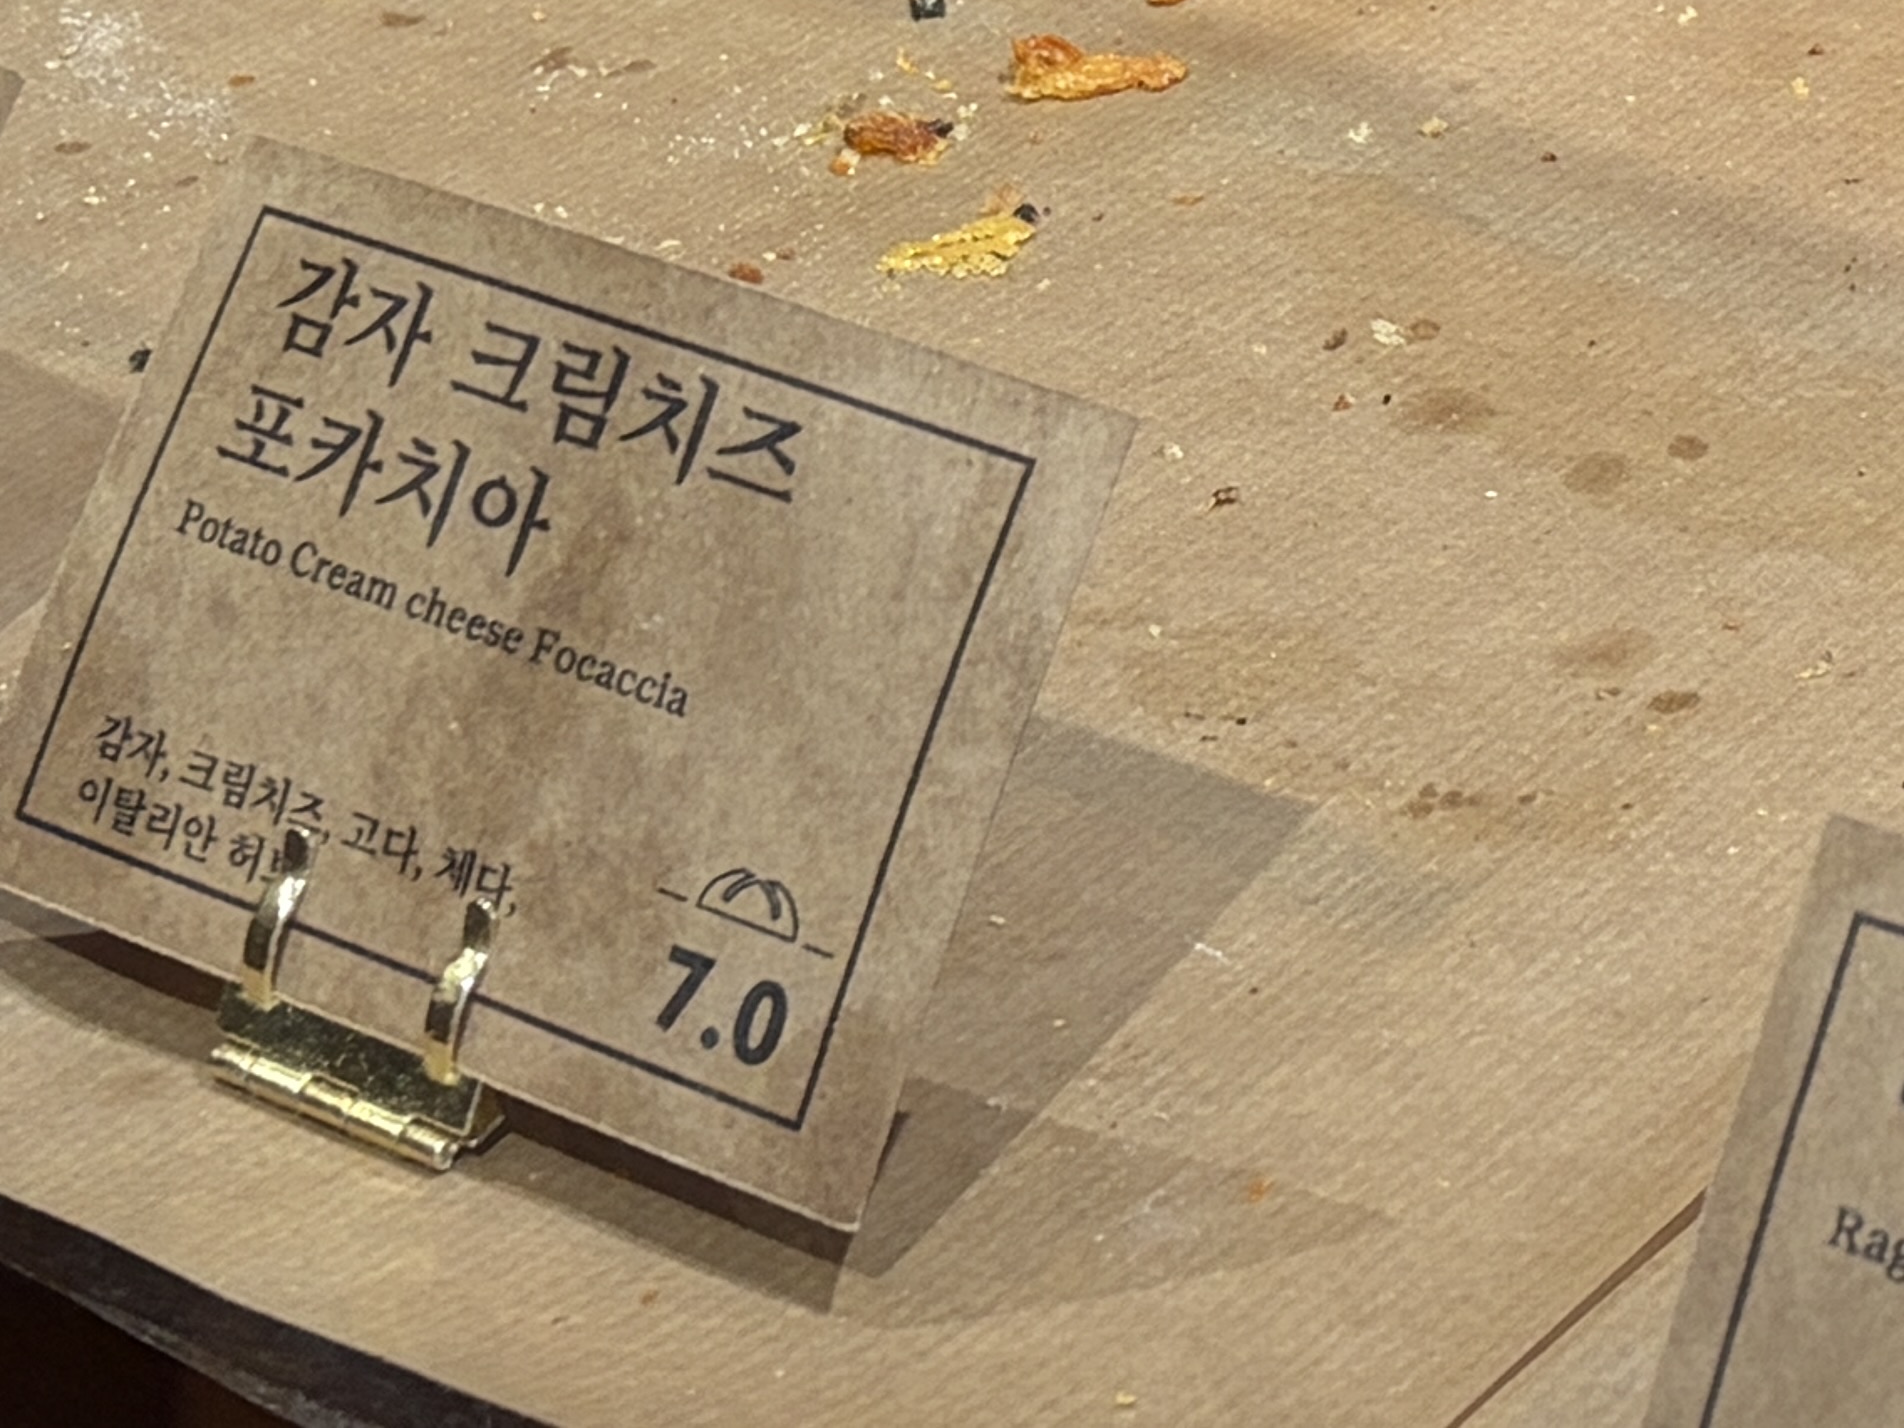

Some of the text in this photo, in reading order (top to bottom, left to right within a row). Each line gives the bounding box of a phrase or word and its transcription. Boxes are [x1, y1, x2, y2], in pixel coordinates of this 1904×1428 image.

[276, 256, 804, 505] 감자 크림치즈
[215, 383, 551, 578] 포카치아
[176, 498, 689, 718] Potato Cream cheese Focaccia
[78, 777, 217, 863] 이탈리안
[96, 715, 516, 917] 감자, 크림치즈, 고다, 체다,
[654, 945, 791, 1067] 7.0
